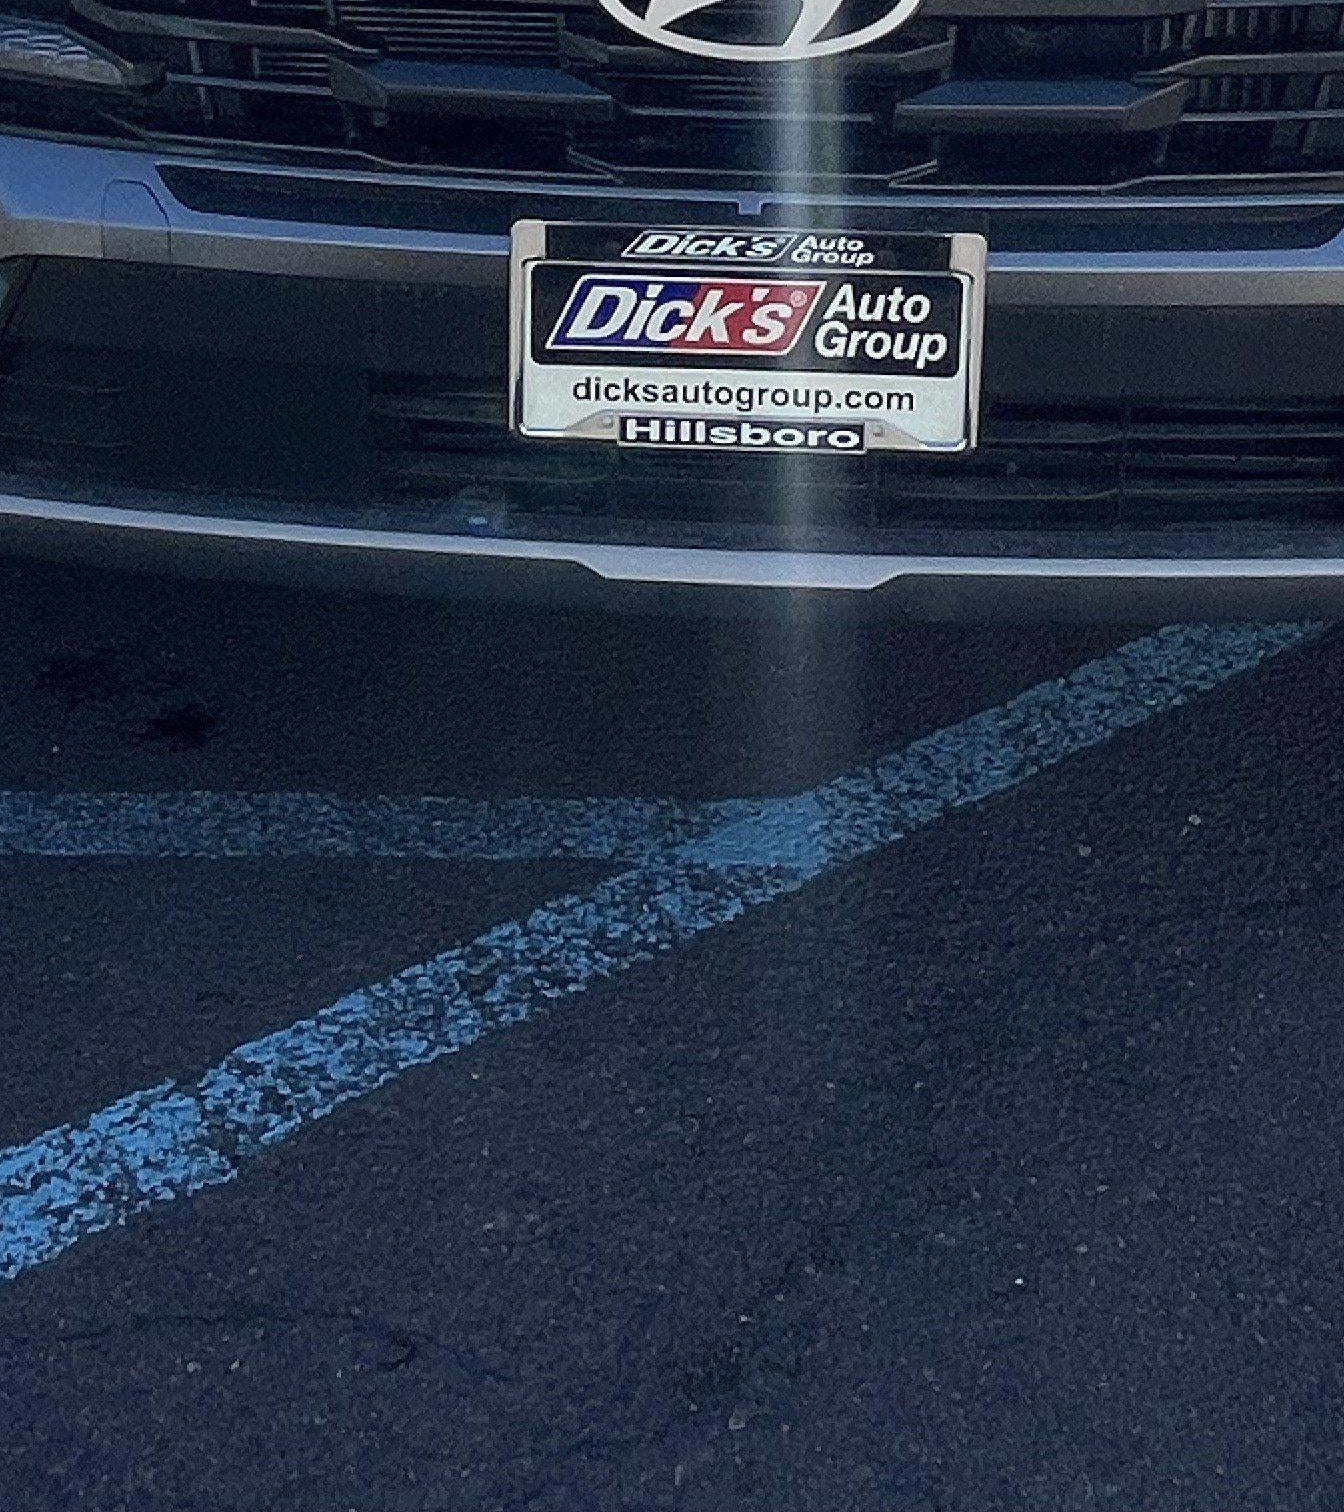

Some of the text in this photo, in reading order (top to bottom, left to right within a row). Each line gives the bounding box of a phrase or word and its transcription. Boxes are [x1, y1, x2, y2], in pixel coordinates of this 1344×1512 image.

[628, 230, 781, 259] Dick's
[789, 248, 874, 268] Group
[794, 234, 864, 253] Auto
[566, 284, 794, 346] Dick's
[823, 283, 932, 323] Auto
[814, 320, 948, 369] Group
[572, 376, 915, 413] dicksautogroup.com
[625, 418, 860, 449] Hillsboro
